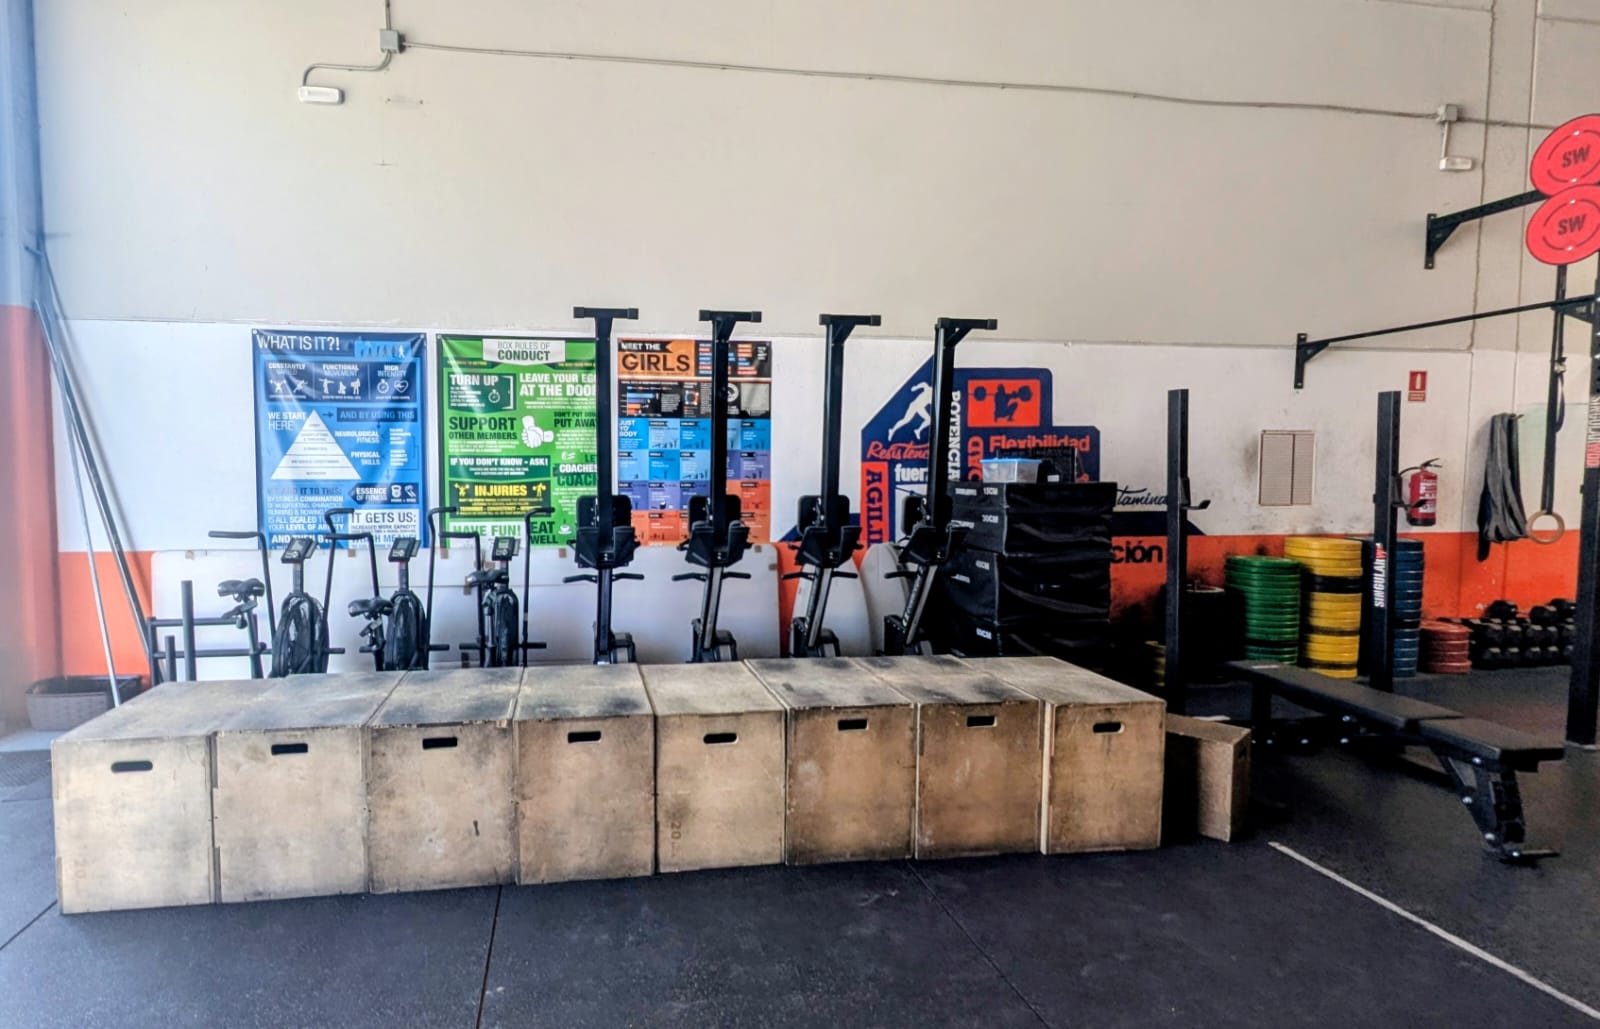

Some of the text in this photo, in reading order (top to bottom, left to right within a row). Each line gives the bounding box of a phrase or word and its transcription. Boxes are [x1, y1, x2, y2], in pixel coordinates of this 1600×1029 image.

[1562, 145, 1590, 168] SW
[1557, 214, 1586, 236] SW
[256, 335, 340, 351] WHAT IS IT?!
[497, 341, 513, 349] BOX
[514, 341, 538, 349] RULES
[497, 350, 551, 361] CONDUCT
[622, 353, 690, 371] GIRLS
[449, 374, 499, 386] TURN UP
[519, 373, 551, 383] LEAVE
[553, 373, 579, 384] YOUR
[519, 384, 536, 396] AT
[538, 384, 563, 396] THE
[268, 412, 306, 420] WE START
[340, 411, 357, 420] AND
[358, 411, 370, 420] BY
[397, 411, 415, 420] THIS
[268, 421, 294, 431] HERE
[448, 416, 517, 431] SUPPORT
[554, 418, 597, 428] PUT AWA
[448, 431, 518, 440] OTHER MEMBERS
[947, 390, 961, 482] POTENCIA
[989, 434, 1091, 453] Flexibilidad
[450, 458, 458, 466] IF
[459, 458, 475, 466] YOU
[476, 458, 499, 466] DON'T
[500, 458, 523, 467] KNOW
[529, 458, 548, 467] ASK!
[300, 487, 307, 495] IT
[356, 487, 387, 495] ESSENCE
[474, 484, 528, 497] INJURIES
[351, 512, 417, 523] IT GETS US:
[491, 525, 521, 537] FUN!
[531, 521, 555, 534] EAT
[271, 534, 291, 543] AND
[530, 535, 559, 545] WELL
